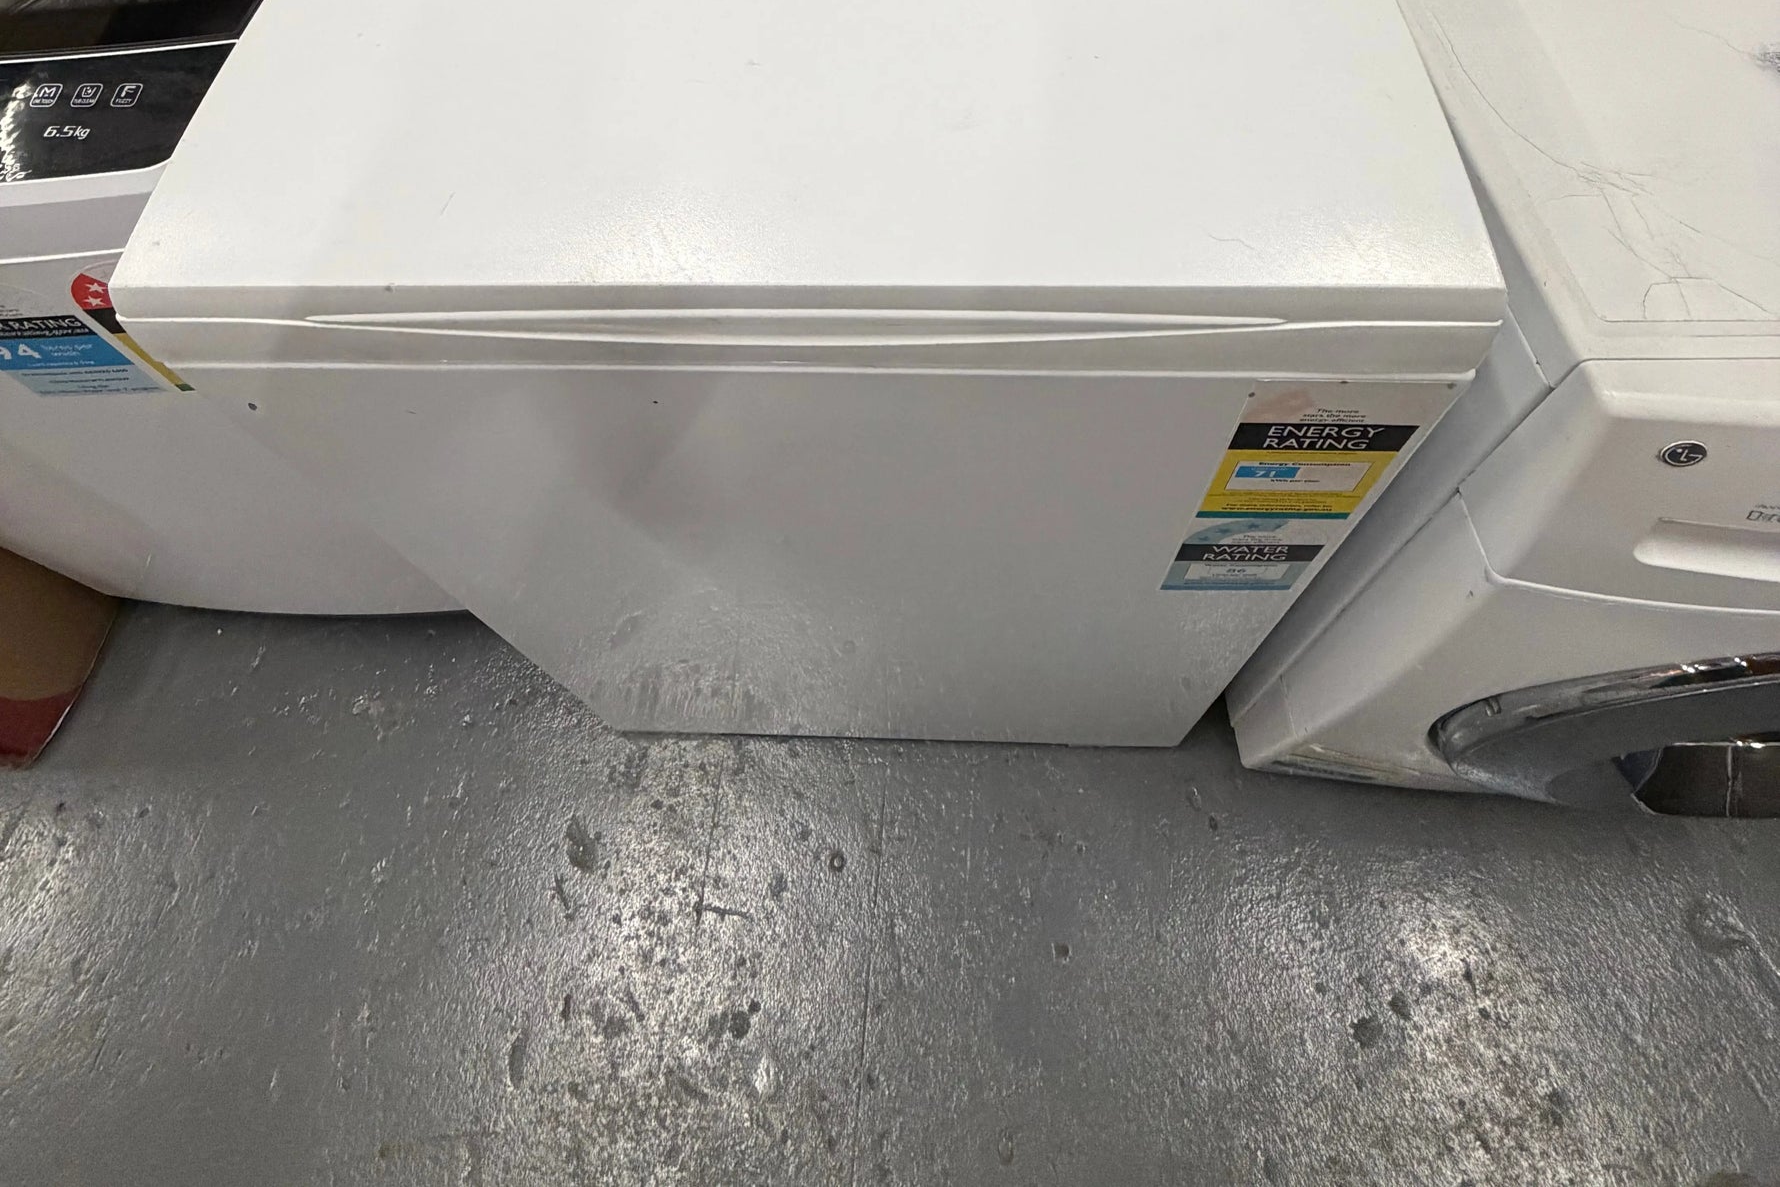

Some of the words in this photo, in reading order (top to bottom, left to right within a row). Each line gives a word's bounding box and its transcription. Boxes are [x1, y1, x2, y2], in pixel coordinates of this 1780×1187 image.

[43, 126, 91, 140] 6.5kg
[11, 318, 82, 330] RATING
[1267, 425, 1385, 439] ENERGY
[1262, 438, 1370, 450] RATING
[1211, 545, 1289, 554] WATER
[1203, 553, 1287, 561] RATING
